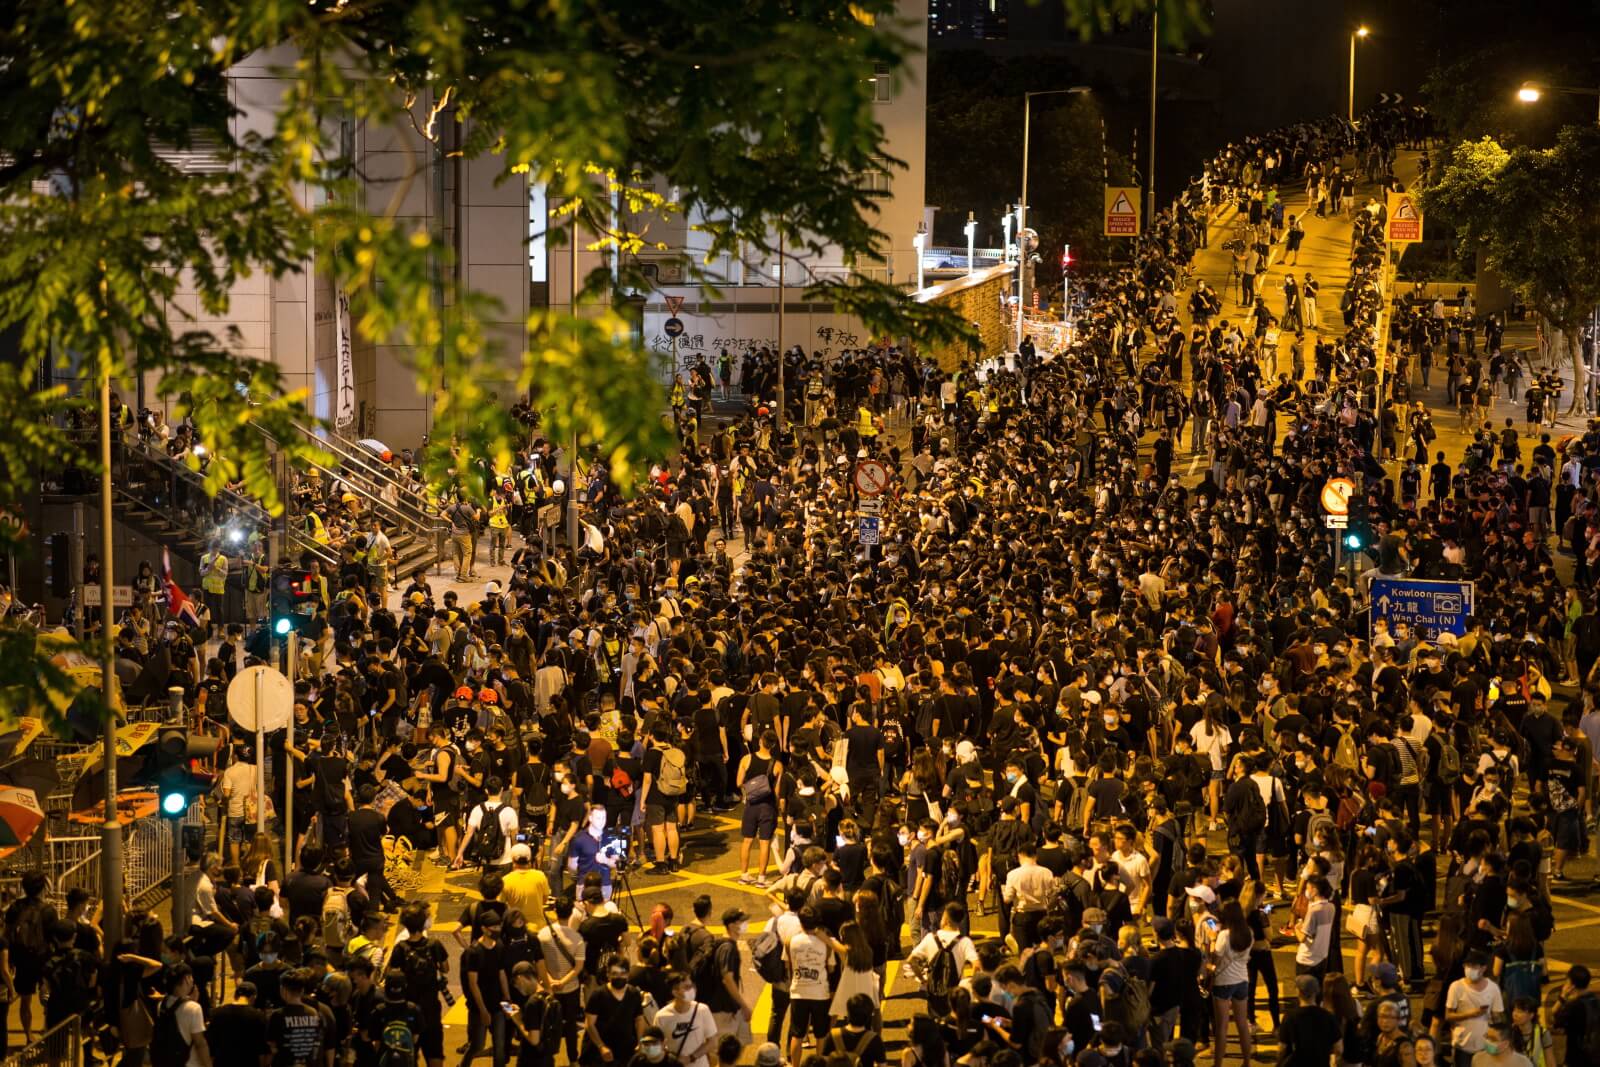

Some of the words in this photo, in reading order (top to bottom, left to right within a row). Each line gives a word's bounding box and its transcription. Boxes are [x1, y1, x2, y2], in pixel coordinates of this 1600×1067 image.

[1391, 588, 1432, 598] Kowloon
[1393, 601, 1419, 613] 九龍
[1392, 613, 1412, 623] Wan
[1415, 615, 1436, 624] Chai
[1439, 615, 1456, 625] (N)
